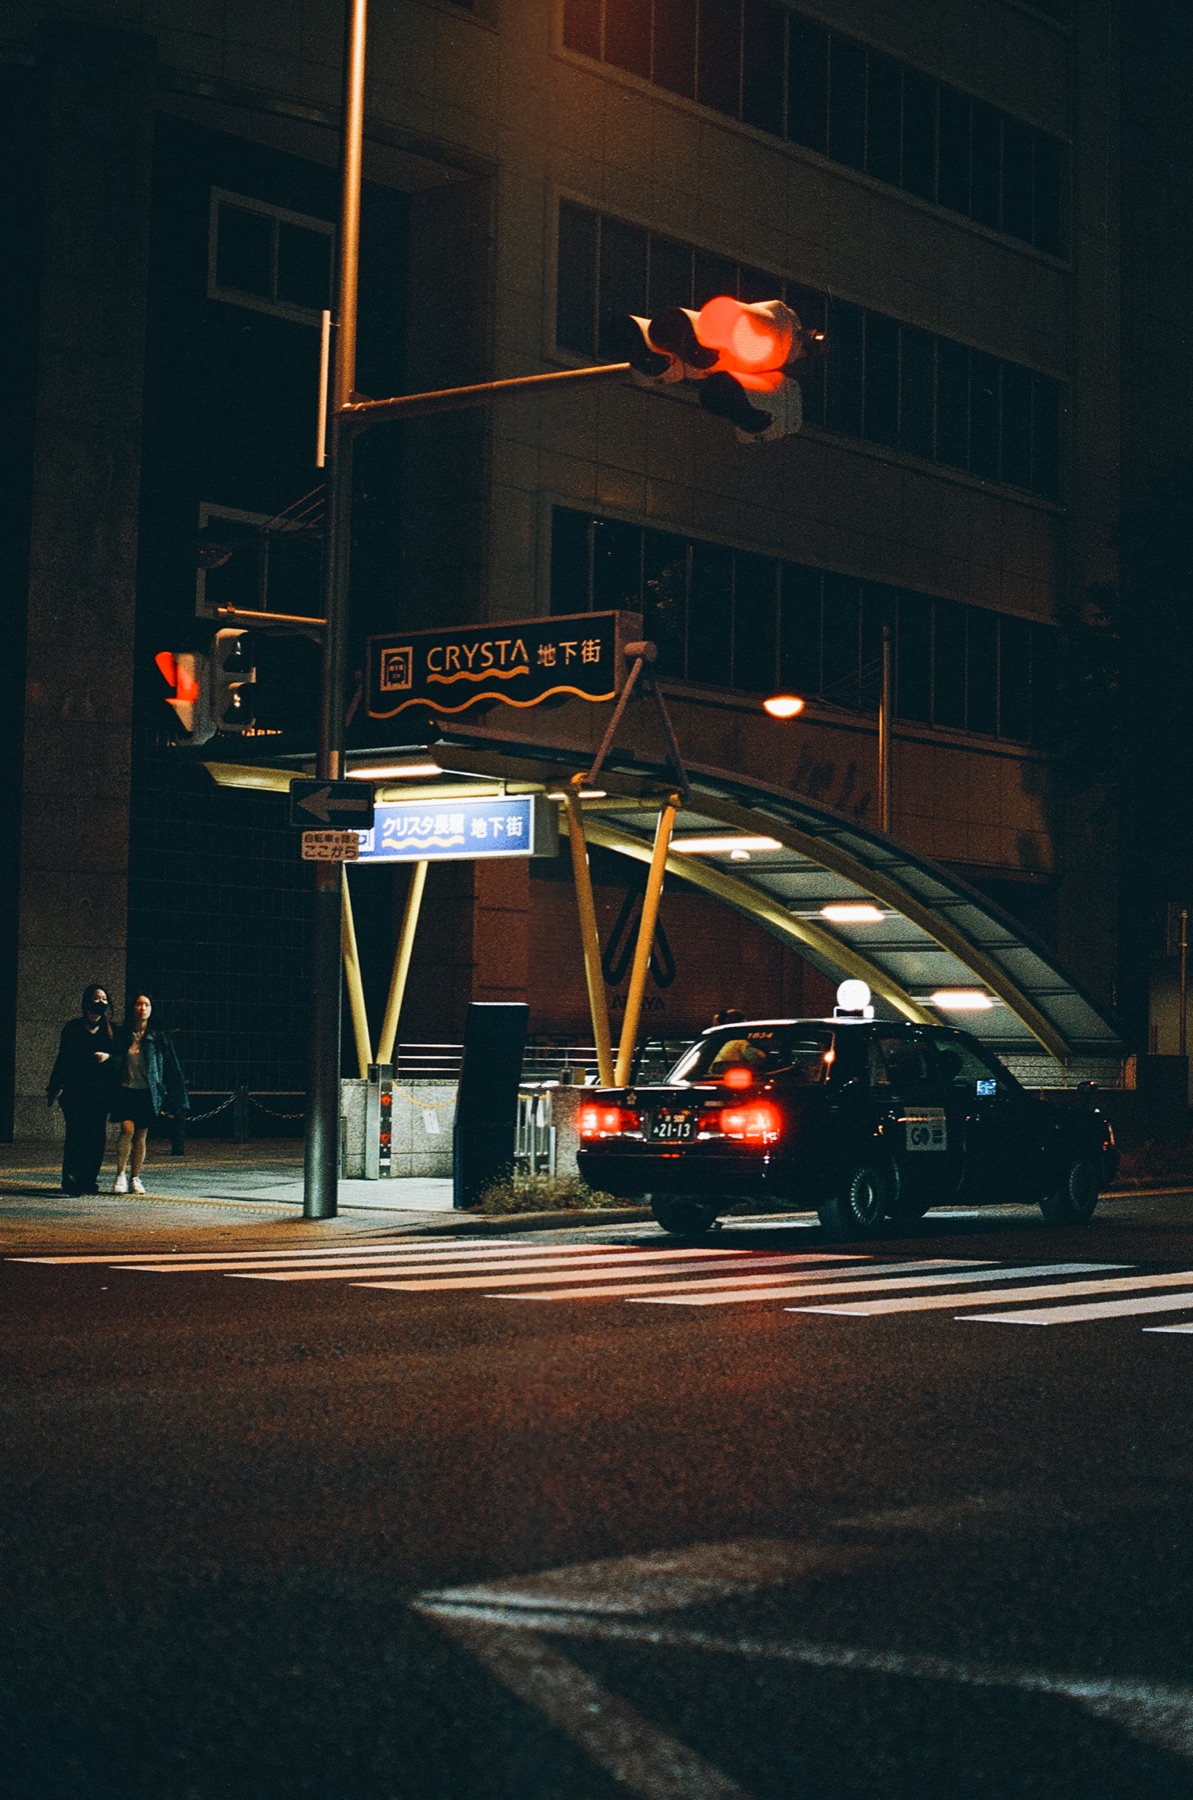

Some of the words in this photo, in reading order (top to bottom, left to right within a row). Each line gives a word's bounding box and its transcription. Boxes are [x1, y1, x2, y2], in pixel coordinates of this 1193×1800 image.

[426, 638, 530, 672] CRYSTA
[536, 638, 602, 667] 地下街
[470, 815, 524, 839] 地下街
[305, 845, 357, 858] ここから
[612, 994, 664, 1010] AYA
